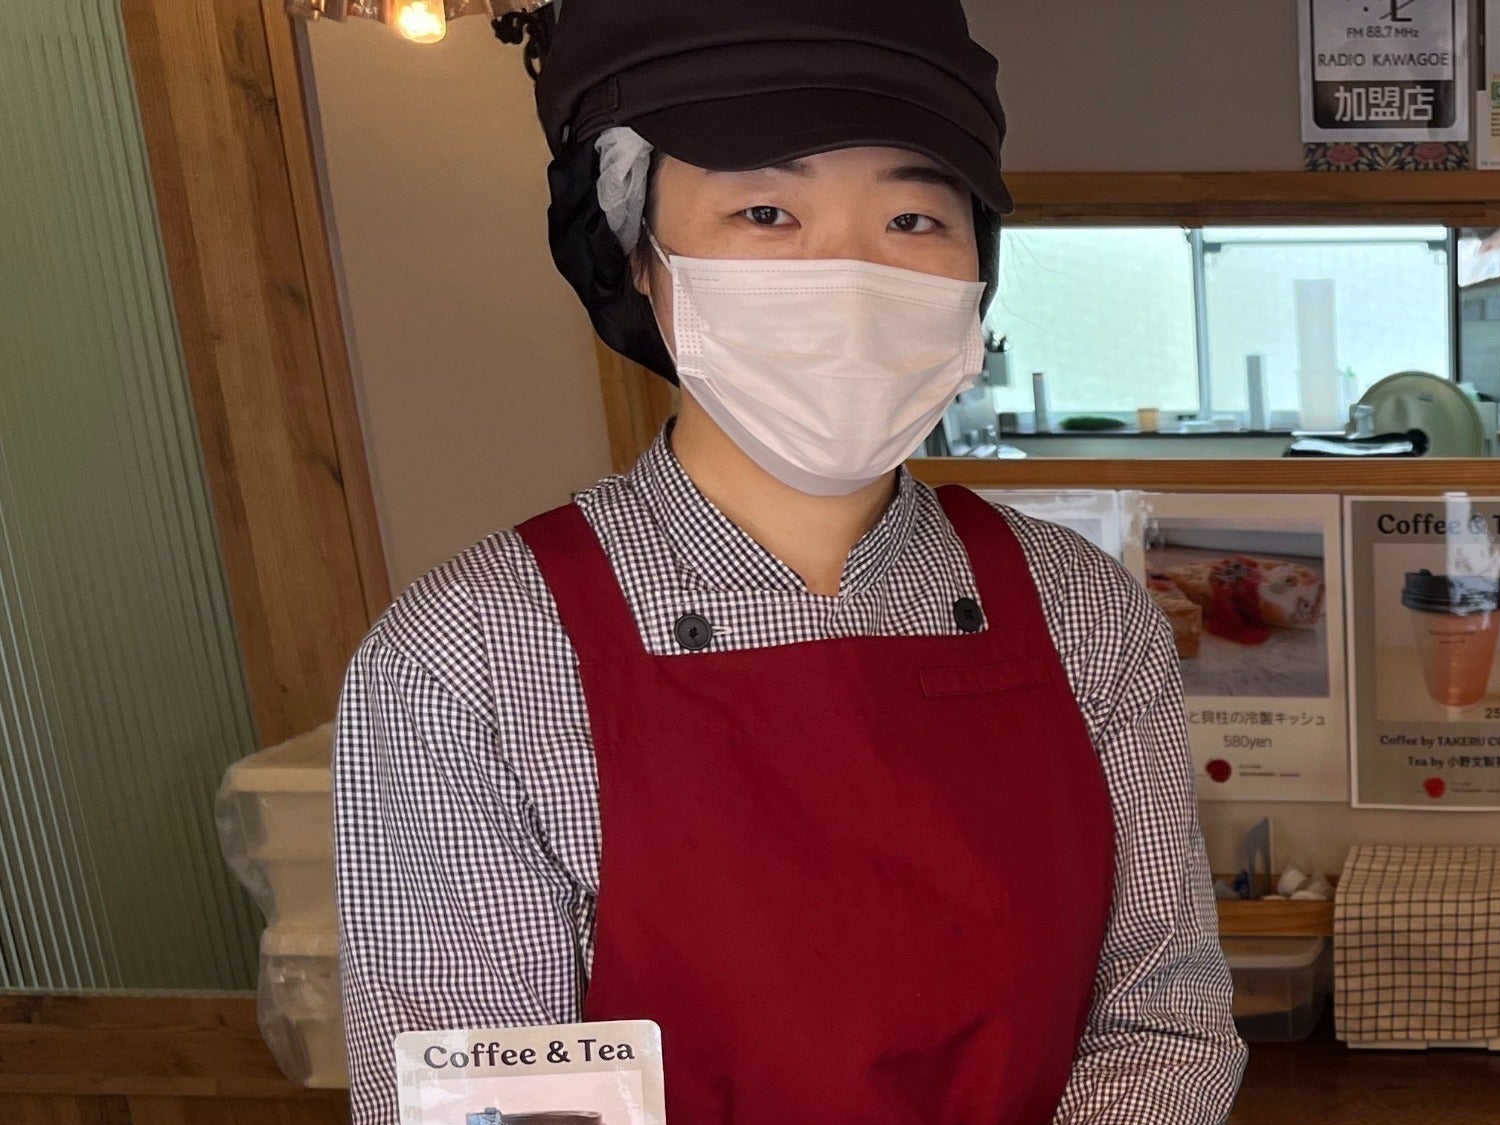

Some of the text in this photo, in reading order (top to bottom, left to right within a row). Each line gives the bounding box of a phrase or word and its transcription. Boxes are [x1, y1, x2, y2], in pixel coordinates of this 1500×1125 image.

[1347, 26, 1419, 38] FM 88.7 MHz
[1318, 53, 1449, 66] RADIO KAWAGOE
[1334, 85, 1435, 122] 加盟店
[1377, 514, 1460, 535] Coffee
[1468, 516, 1483, 535] &
[1224, 735, 1272, 749] 580yen
[1379, 735, 1418, 746] Coffee
[1420, 736, 1435, 748] by
[1437, 736, 1485, 746] TAKERU
[1408, 756, 1428, 766] Tea
[1430, 756, 1445, 768] by
[423, 1038, 635, 1069] Coffee & Tea
